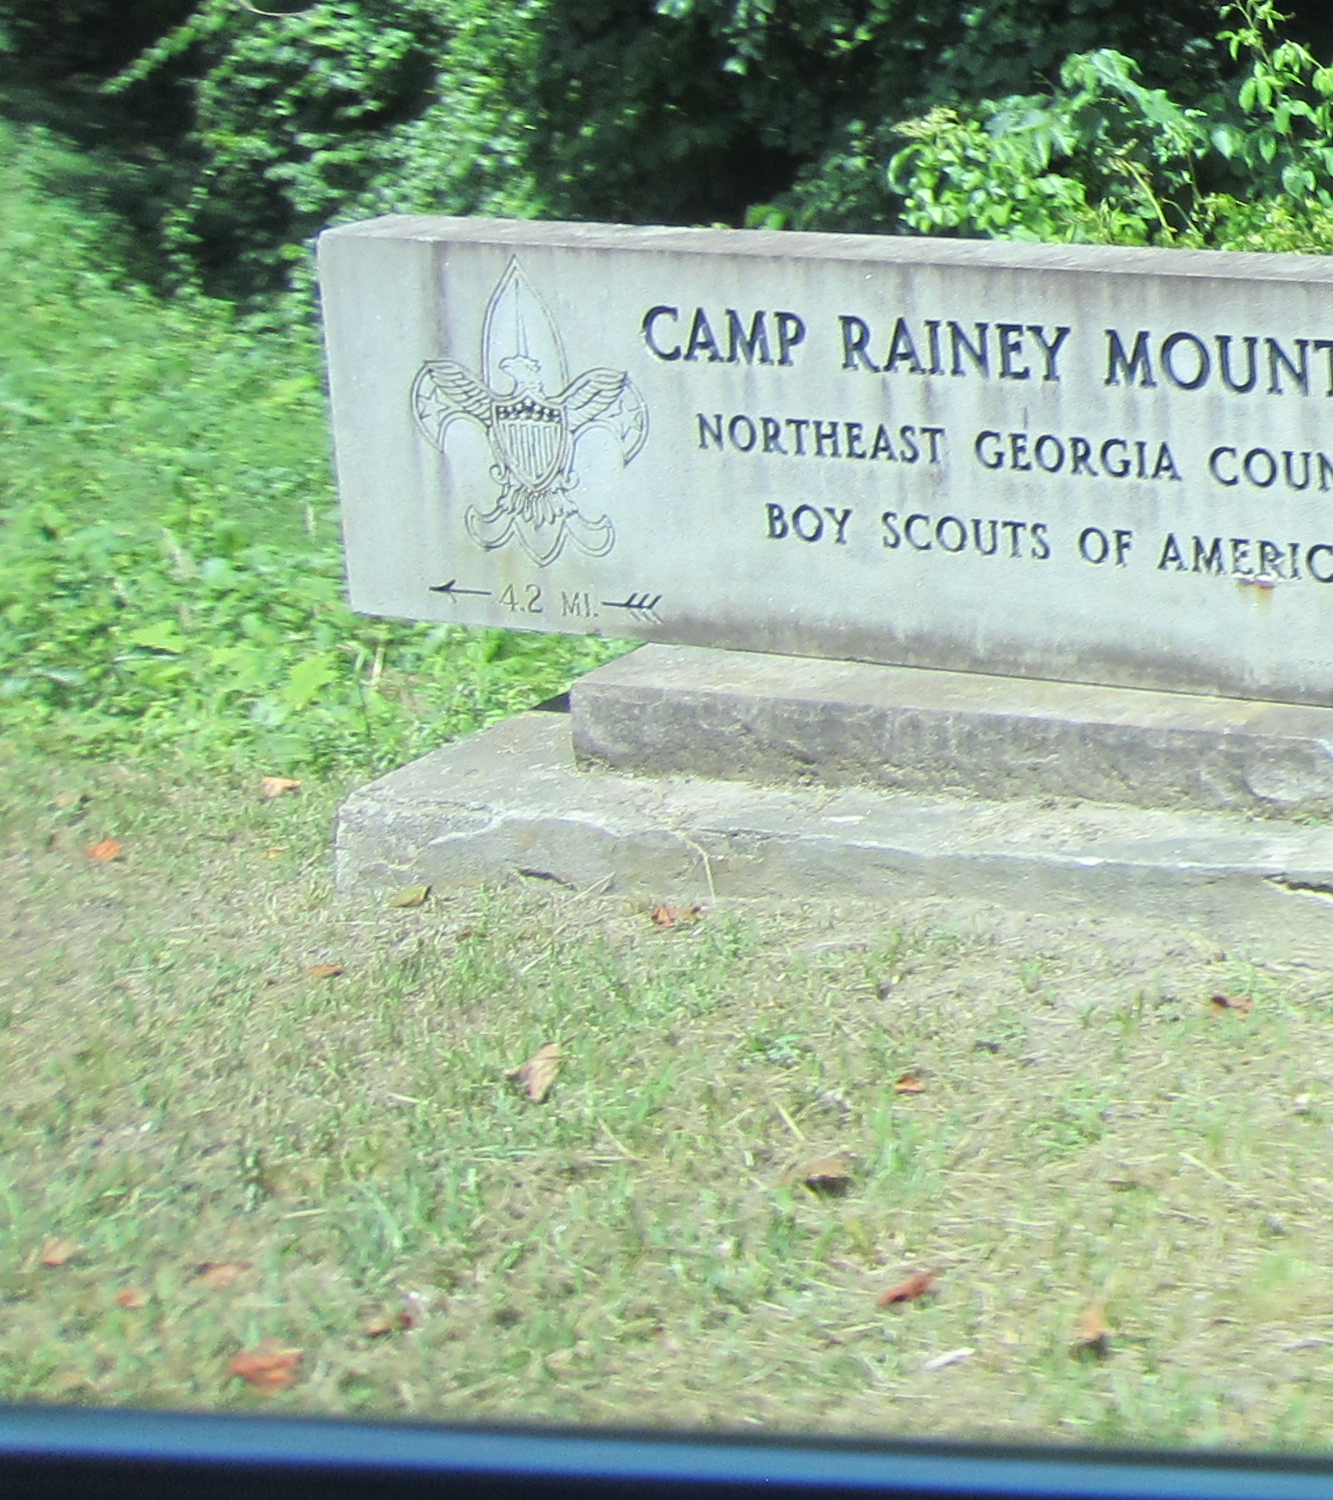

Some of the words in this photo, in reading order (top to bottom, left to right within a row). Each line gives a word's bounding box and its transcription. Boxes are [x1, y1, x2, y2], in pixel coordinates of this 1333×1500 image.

[641, 305, 805, 365] CAMP
[839, 314, 1071, 381] RAINEY
[697, 414, 945, 465] NORTHEAST
[975, 431, 1181, 481] GEORGIA
[766, 503, 851, 545] BOY
[882, 512, 1051, 559] SCOUTS
[1079, 527, 1134, 567] OF
[499, 583, 542, 614] 4.2
